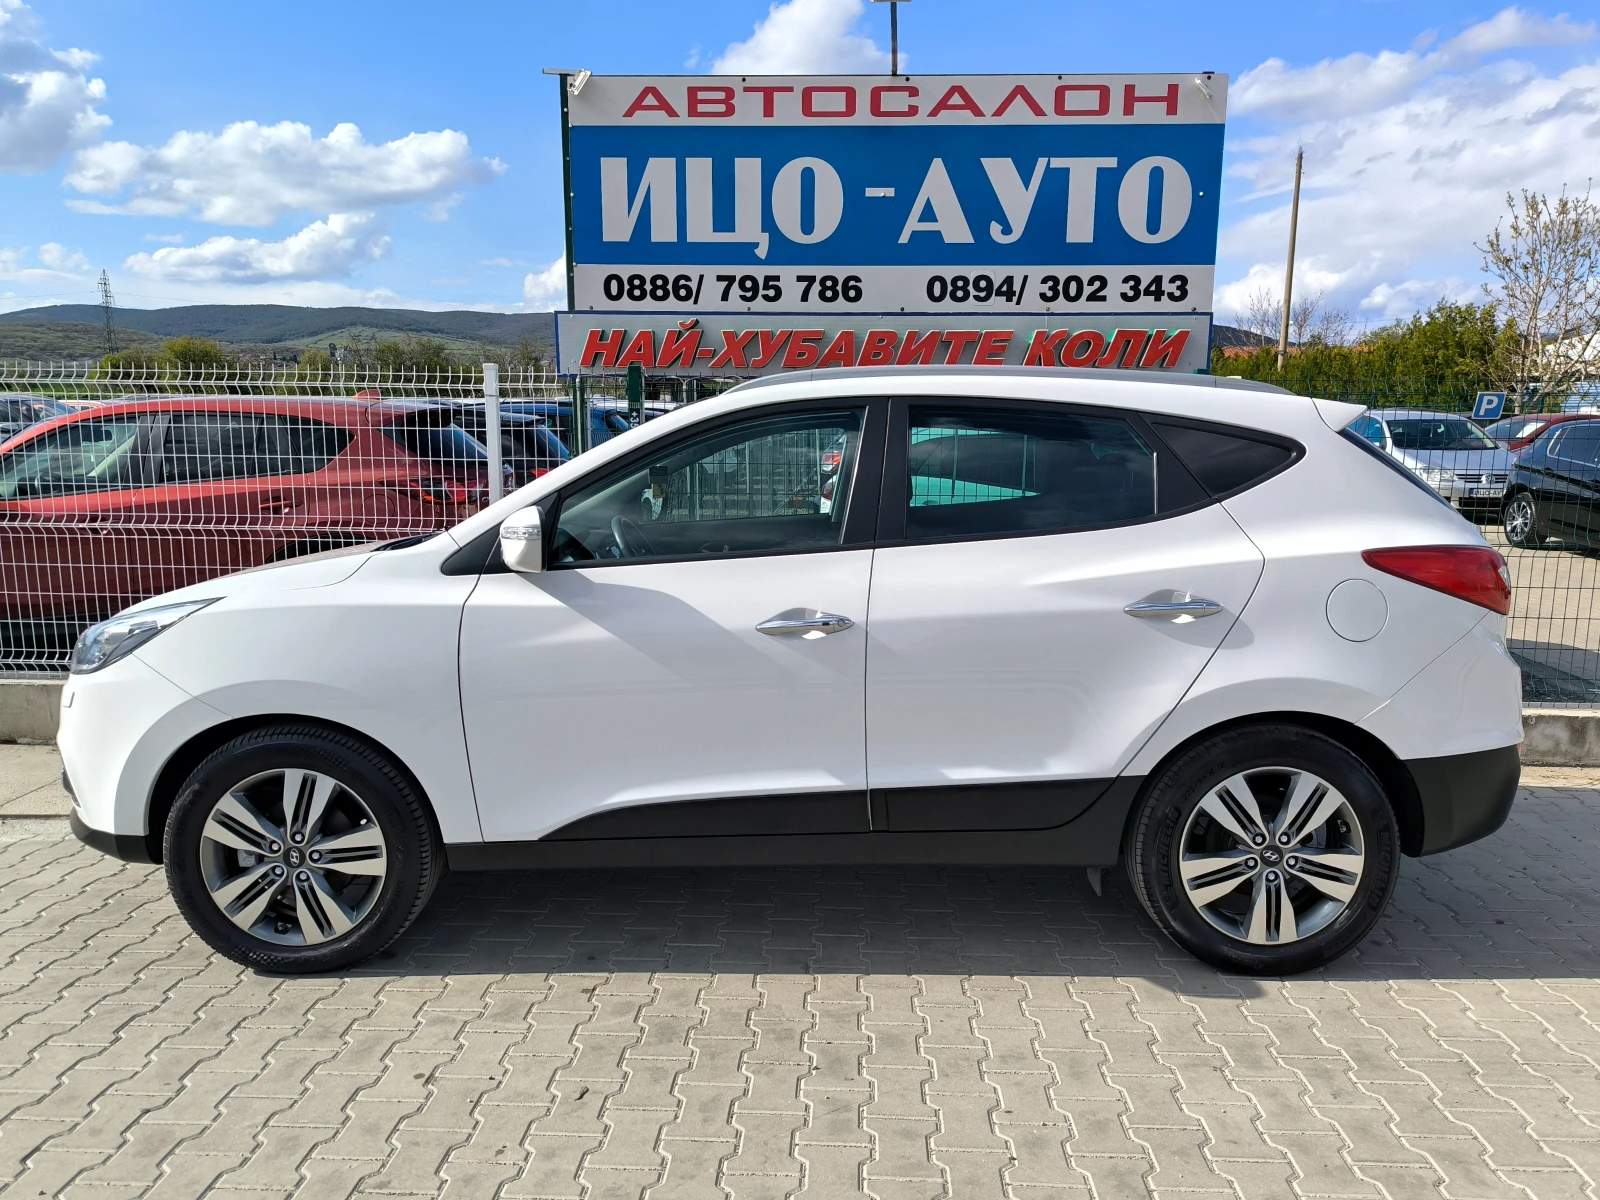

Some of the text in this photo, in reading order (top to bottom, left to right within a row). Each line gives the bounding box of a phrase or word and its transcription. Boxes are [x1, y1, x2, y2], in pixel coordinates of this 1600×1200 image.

[623, 84, 1179, 118] АВТОСАЛОН
[600, 156, 844, 260] ИЦО
[603, 273, 863, 305] 0886/ 795 786
[926, 274, 1189, 306] 0894/ 302 343
[579, 318, 1192, 369] НАЙ-ХУБАВИТЕ КОЛИ
[1479, 395, 1498, 416] P
[1158, 806, 1180, 886] MICHELIN
[1369, 831, 1391, 904] MICHELIN
